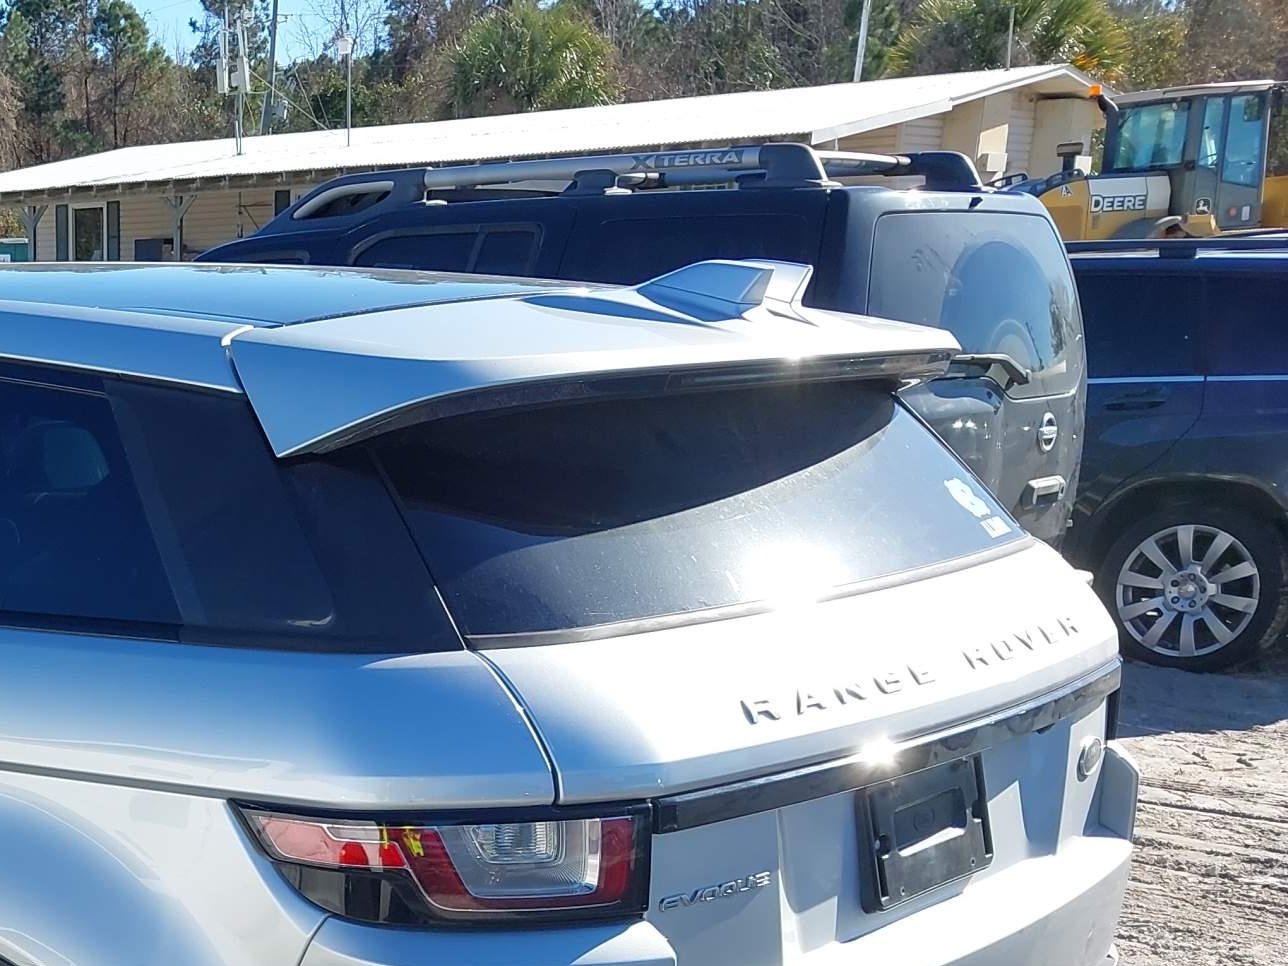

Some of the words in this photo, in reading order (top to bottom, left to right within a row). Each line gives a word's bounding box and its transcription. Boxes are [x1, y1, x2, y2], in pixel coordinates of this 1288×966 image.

[1091, 194, 1147, 214] DEERE
[740, 664, 936, 725] RANGE
[961, 617, 1079, 670] ROVER
[658, 871, 771, 912] EVOQUE
